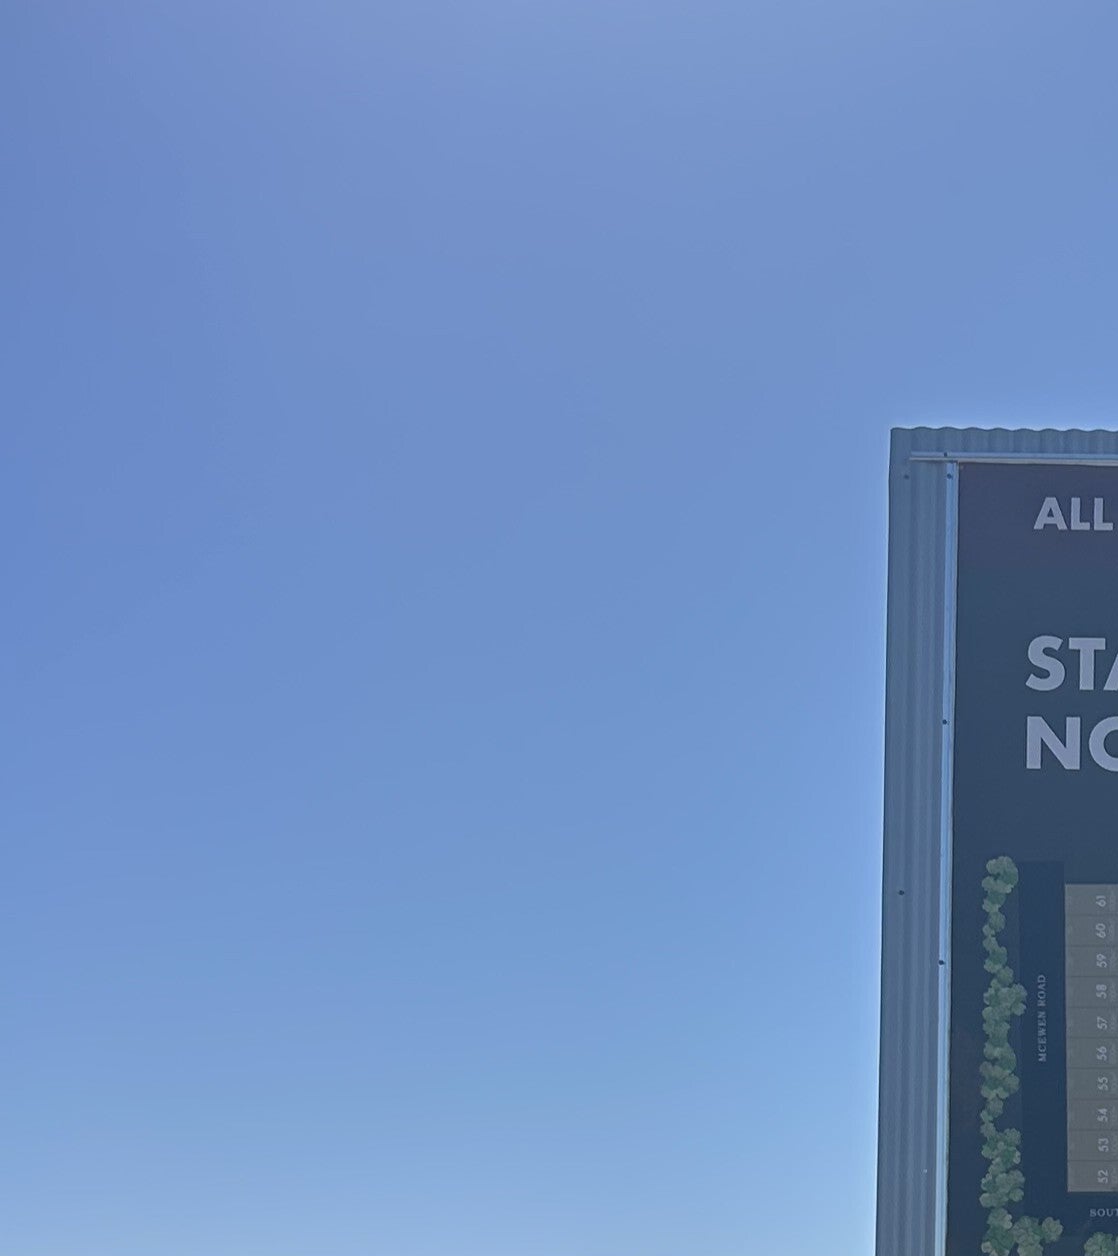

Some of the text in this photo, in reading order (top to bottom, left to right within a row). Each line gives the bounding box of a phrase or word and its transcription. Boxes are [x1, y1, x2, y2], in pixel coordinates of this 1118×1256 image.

[1033, 496, 1114, 531] ALL
[1095, 895, 1107, 908] 61
[1095, 923, 1107, 939] 60
[1096, 953, 1108, 968] 59
[1037, 974, 1047, 1007] ROAD
[1095, 984, 1107, 1000] 58
[1096, 1016, 1108, 1030] 57
[1096, 1045, 1108, 1061] 56
[1097, 1076, 1109, 1091] 55
[1097, 1108, 1108, 1123] 54
[1097, 1137, 1109, 1153] 53
[1097, 1169, 1109, 1184] 52
